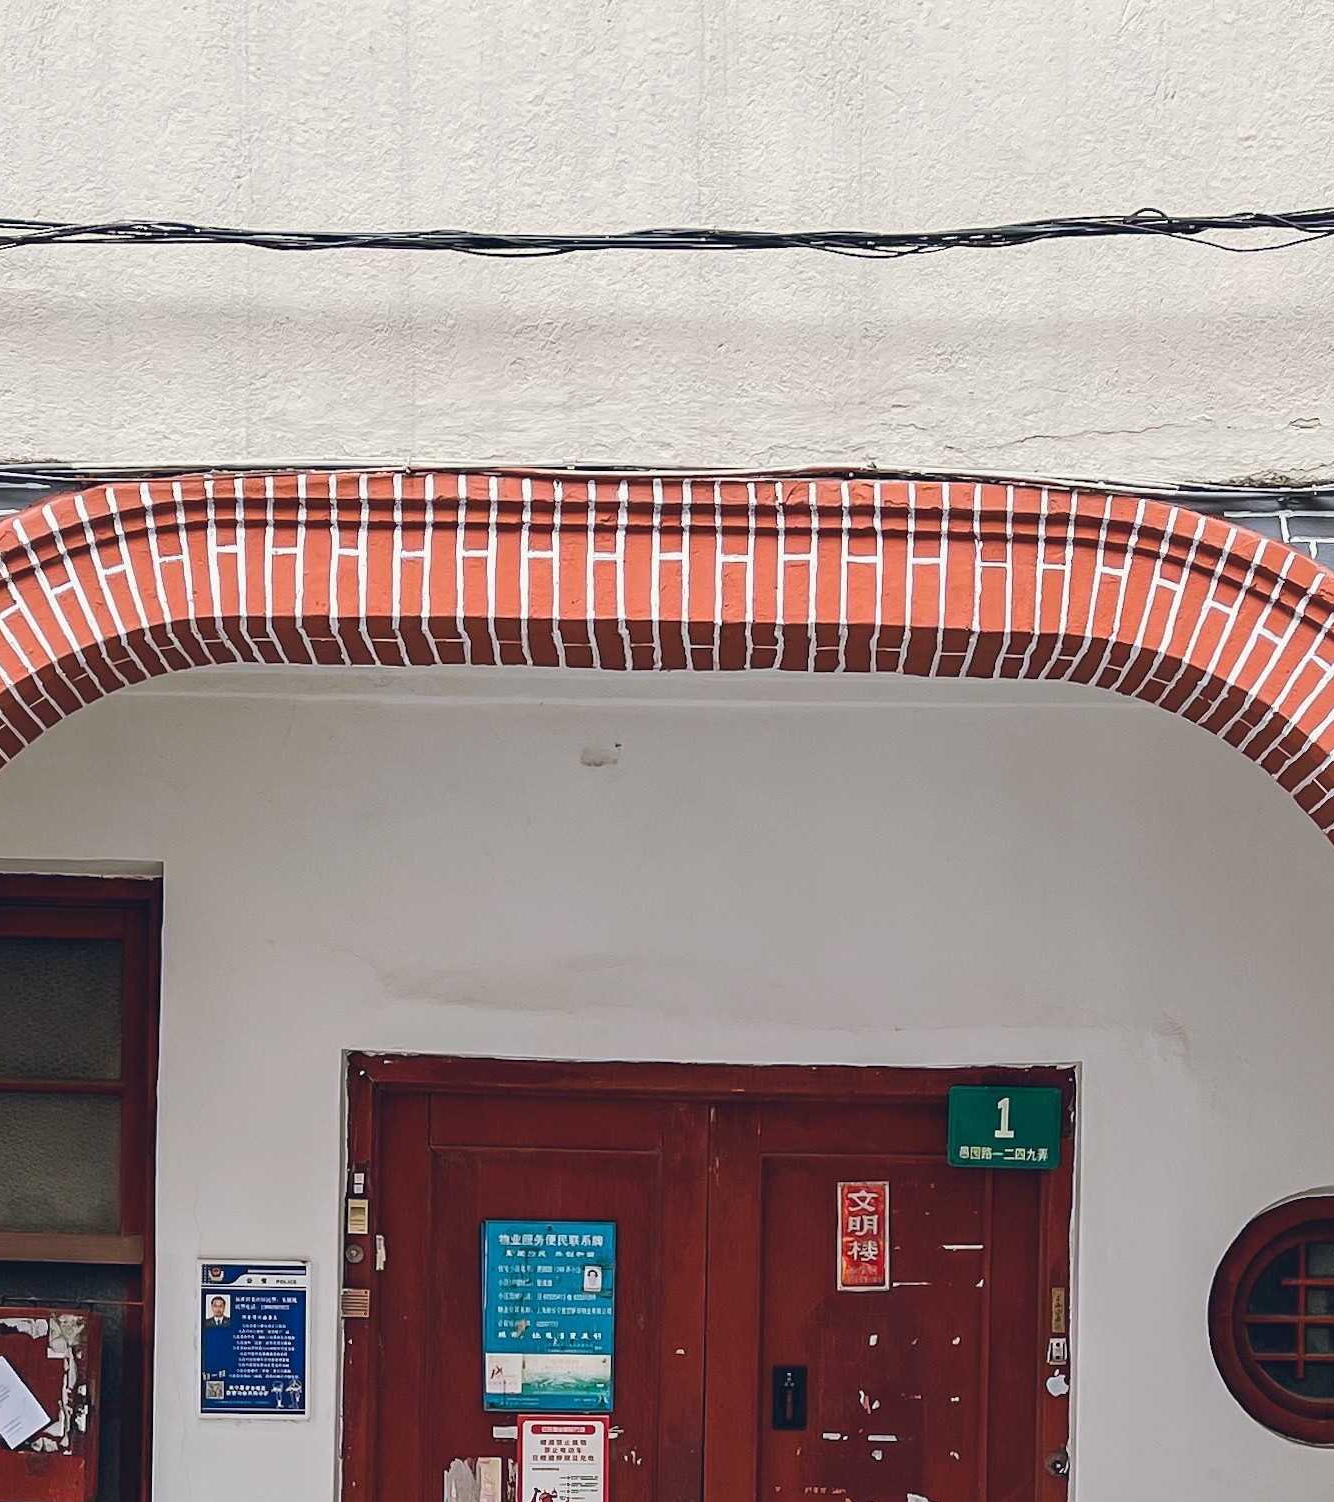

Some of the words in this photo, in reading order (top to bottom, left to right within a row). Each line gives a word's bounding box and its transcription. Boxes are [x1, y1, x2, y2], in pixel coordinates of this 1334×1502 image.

[994, 1097, 1014, 1138] 1
[847, 1190, 879, 1262] 文明楼
